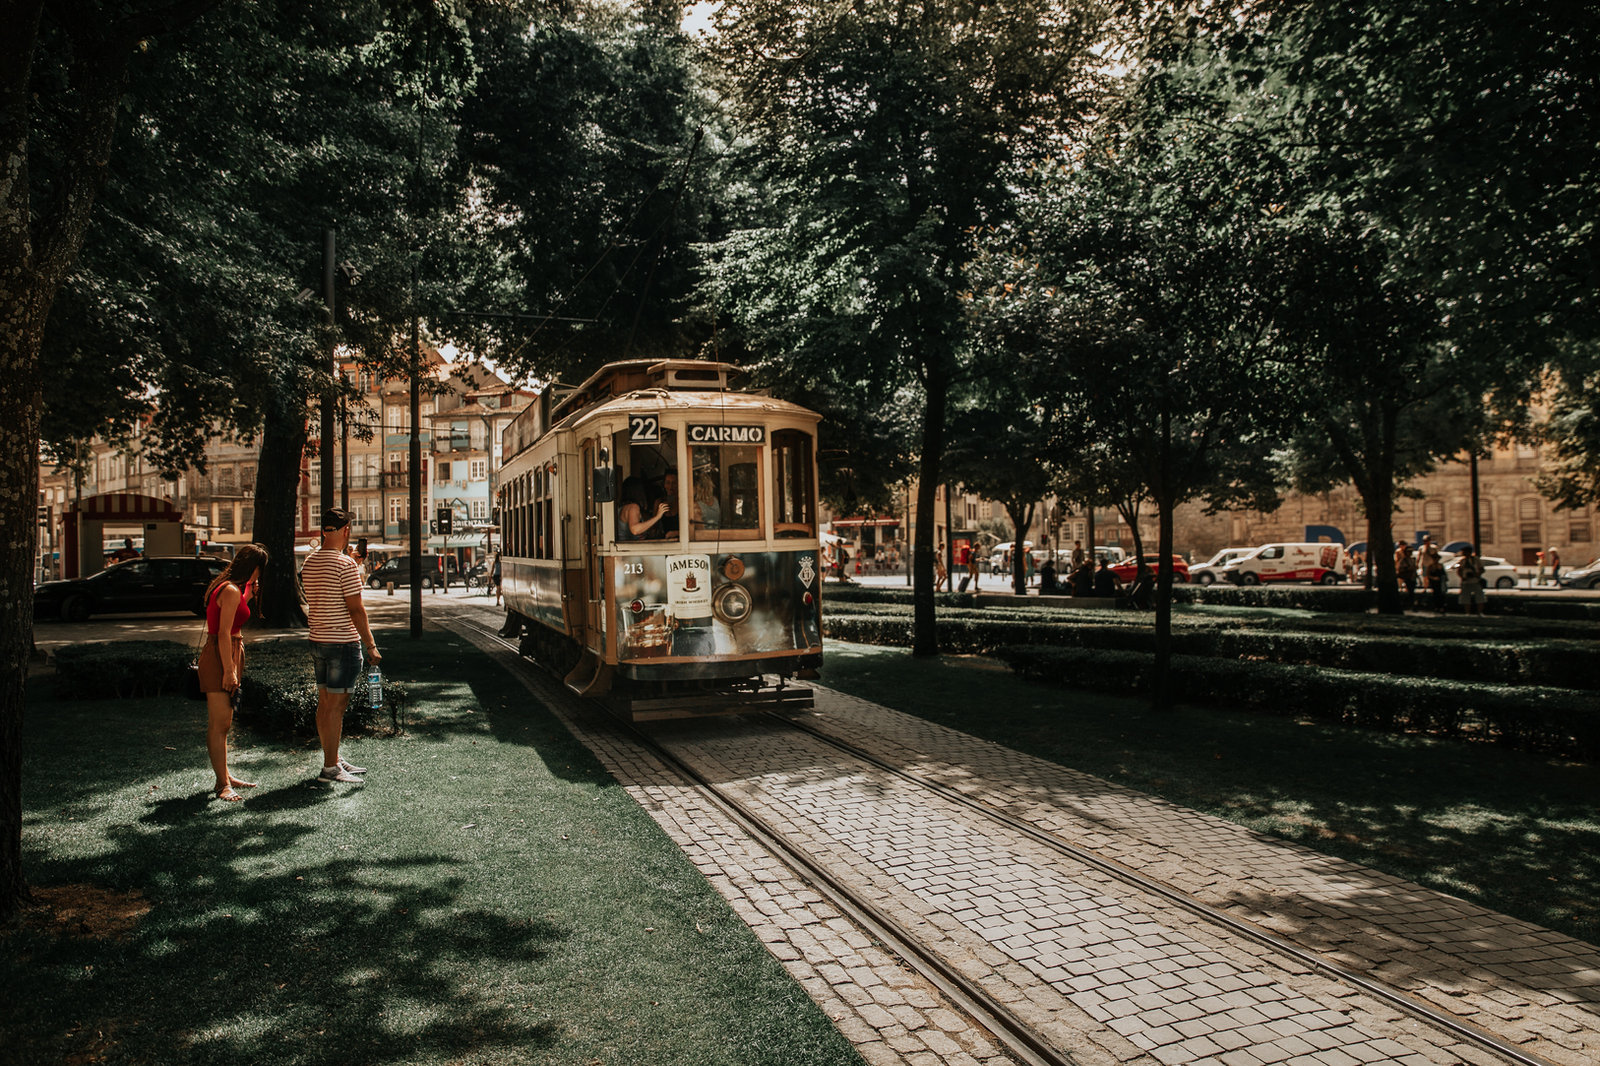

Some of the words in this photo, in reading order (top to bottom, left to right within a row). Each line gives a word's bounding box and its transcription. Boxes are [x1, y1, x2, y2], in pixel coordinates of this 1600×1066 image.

[631, 417, 657, 440] 22
[691, 426, 762, 442] CARMO
[623, 563, 643, 574] 213
